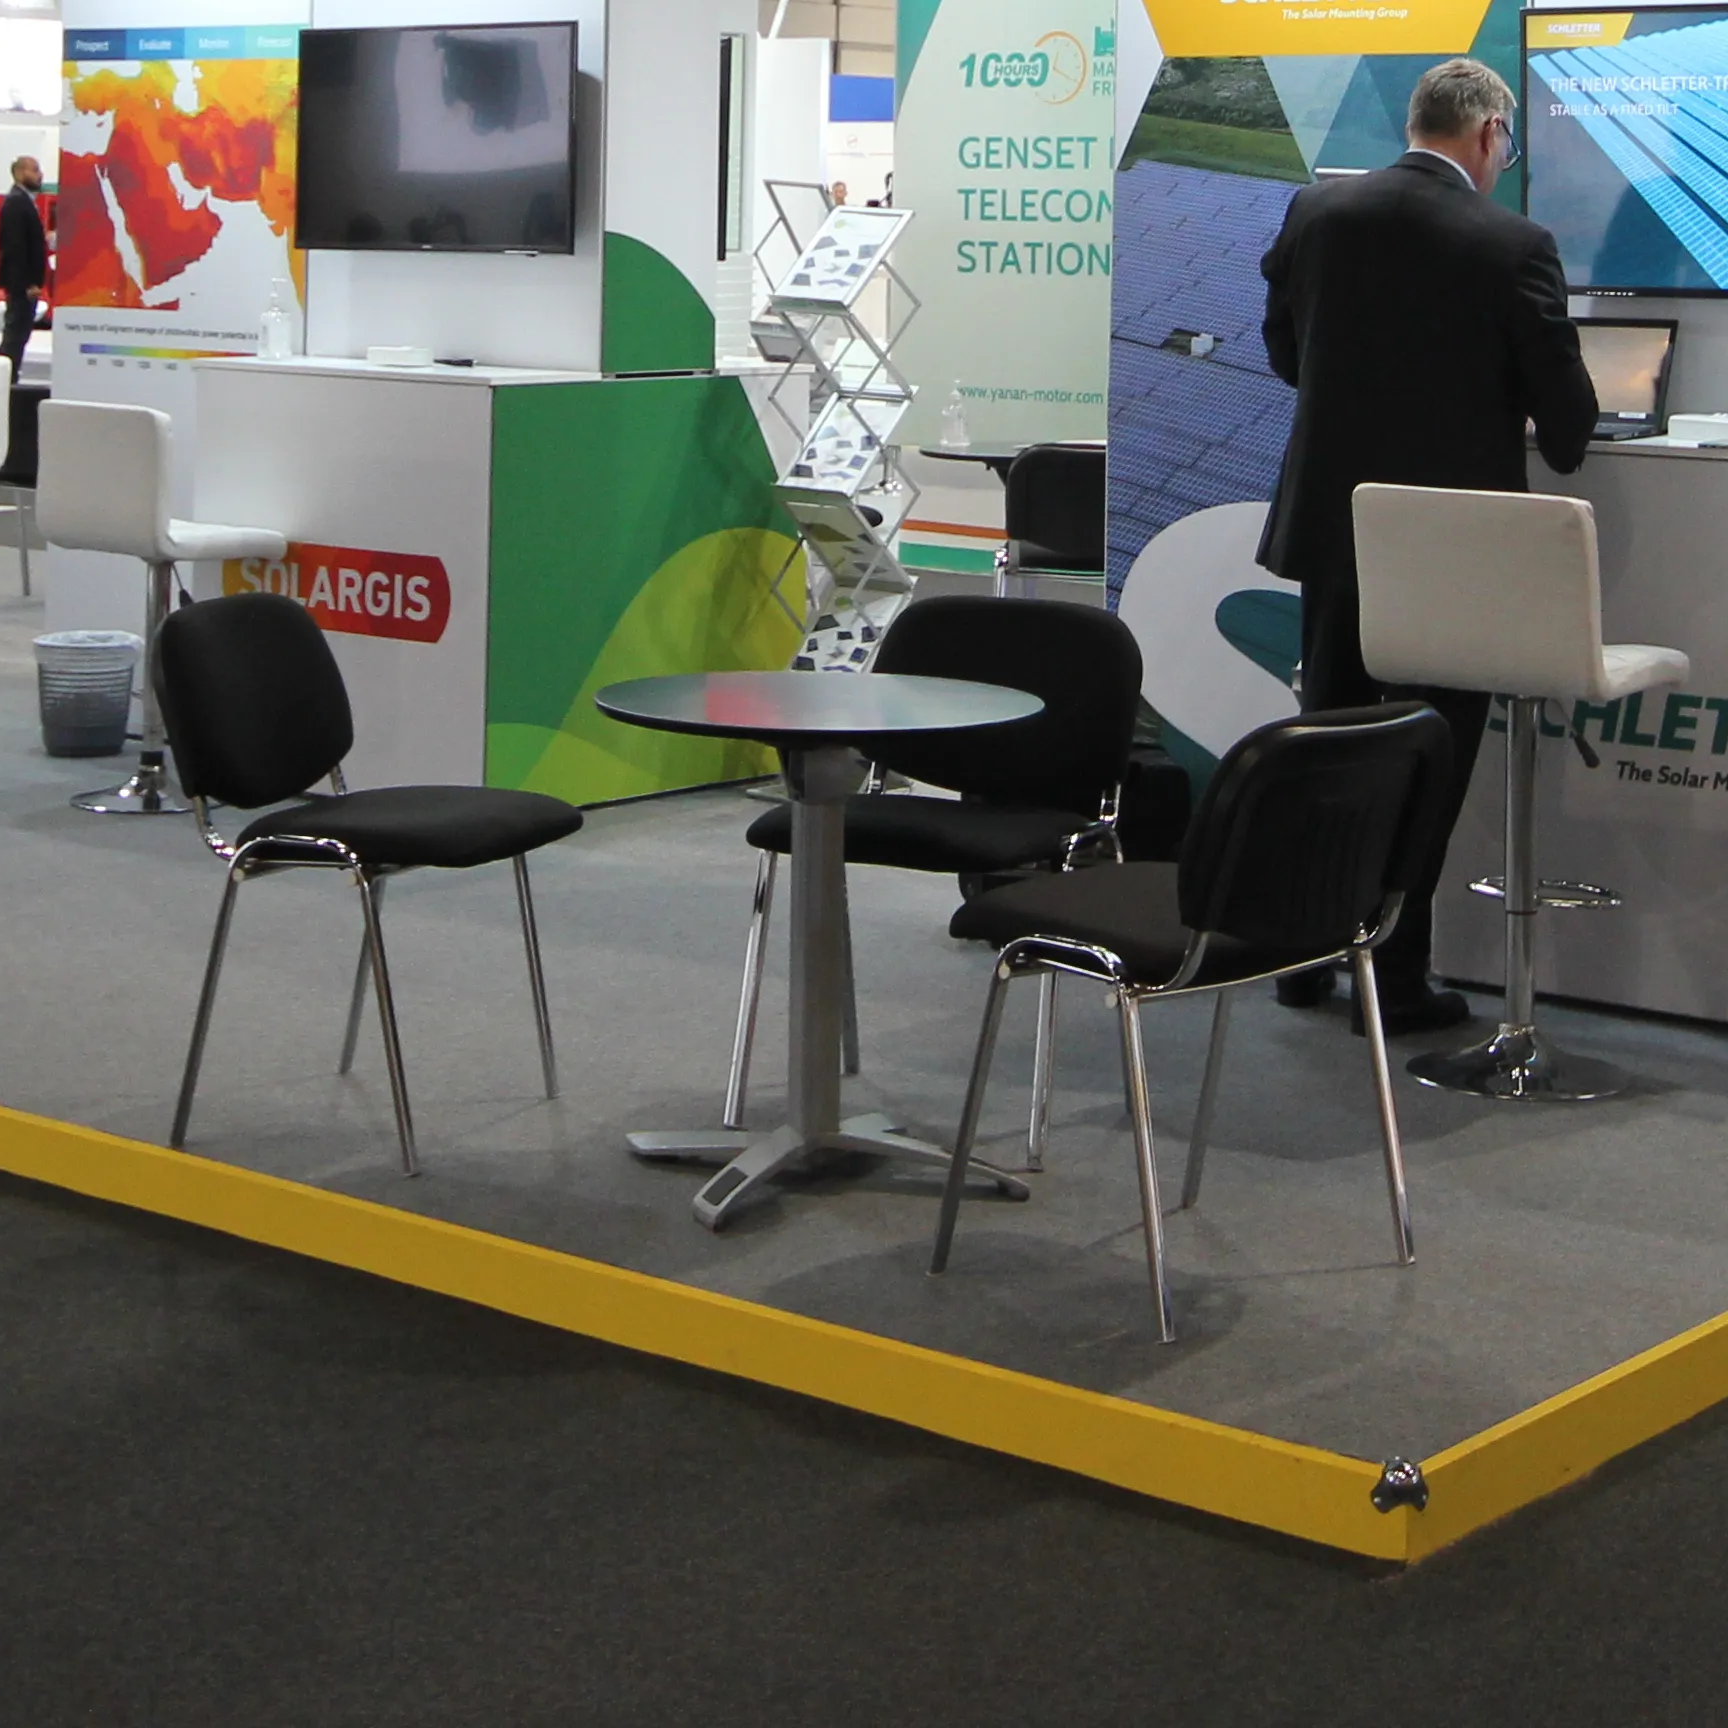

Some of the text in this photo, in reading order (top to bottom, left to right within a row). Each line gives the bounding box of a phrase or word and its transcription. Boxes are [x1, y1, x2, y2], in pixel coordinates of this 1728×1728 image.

[1282, 7, 1408, 20] The Solar Mounting Group
[1546, 22, 1602, 34] SCHLETTER
[993, 64, 1040, 77] HOURS
[1092, 80, 1114, 97] FR
[1550, 77, 1578, 93] THE
[1580, 76, 1618, 92] NEW
[1549, 104, 1590, 117] STABLE
[1593, 103, 1609, 117] AS
[1621, 103, 1653, 117] FIXED
[1654, 103, 1680, 117] TILT
[958, 136, 1098, 170] GENSET
[956, 239, 1111, 276] STATION
[957, 385, 1103, 405] www.yanan-motor.com
[239, 558, 432, 622] SOLARGIS
[1615, 760, 1652, 783] The
[1657, 765, 1707, 790] Solar
